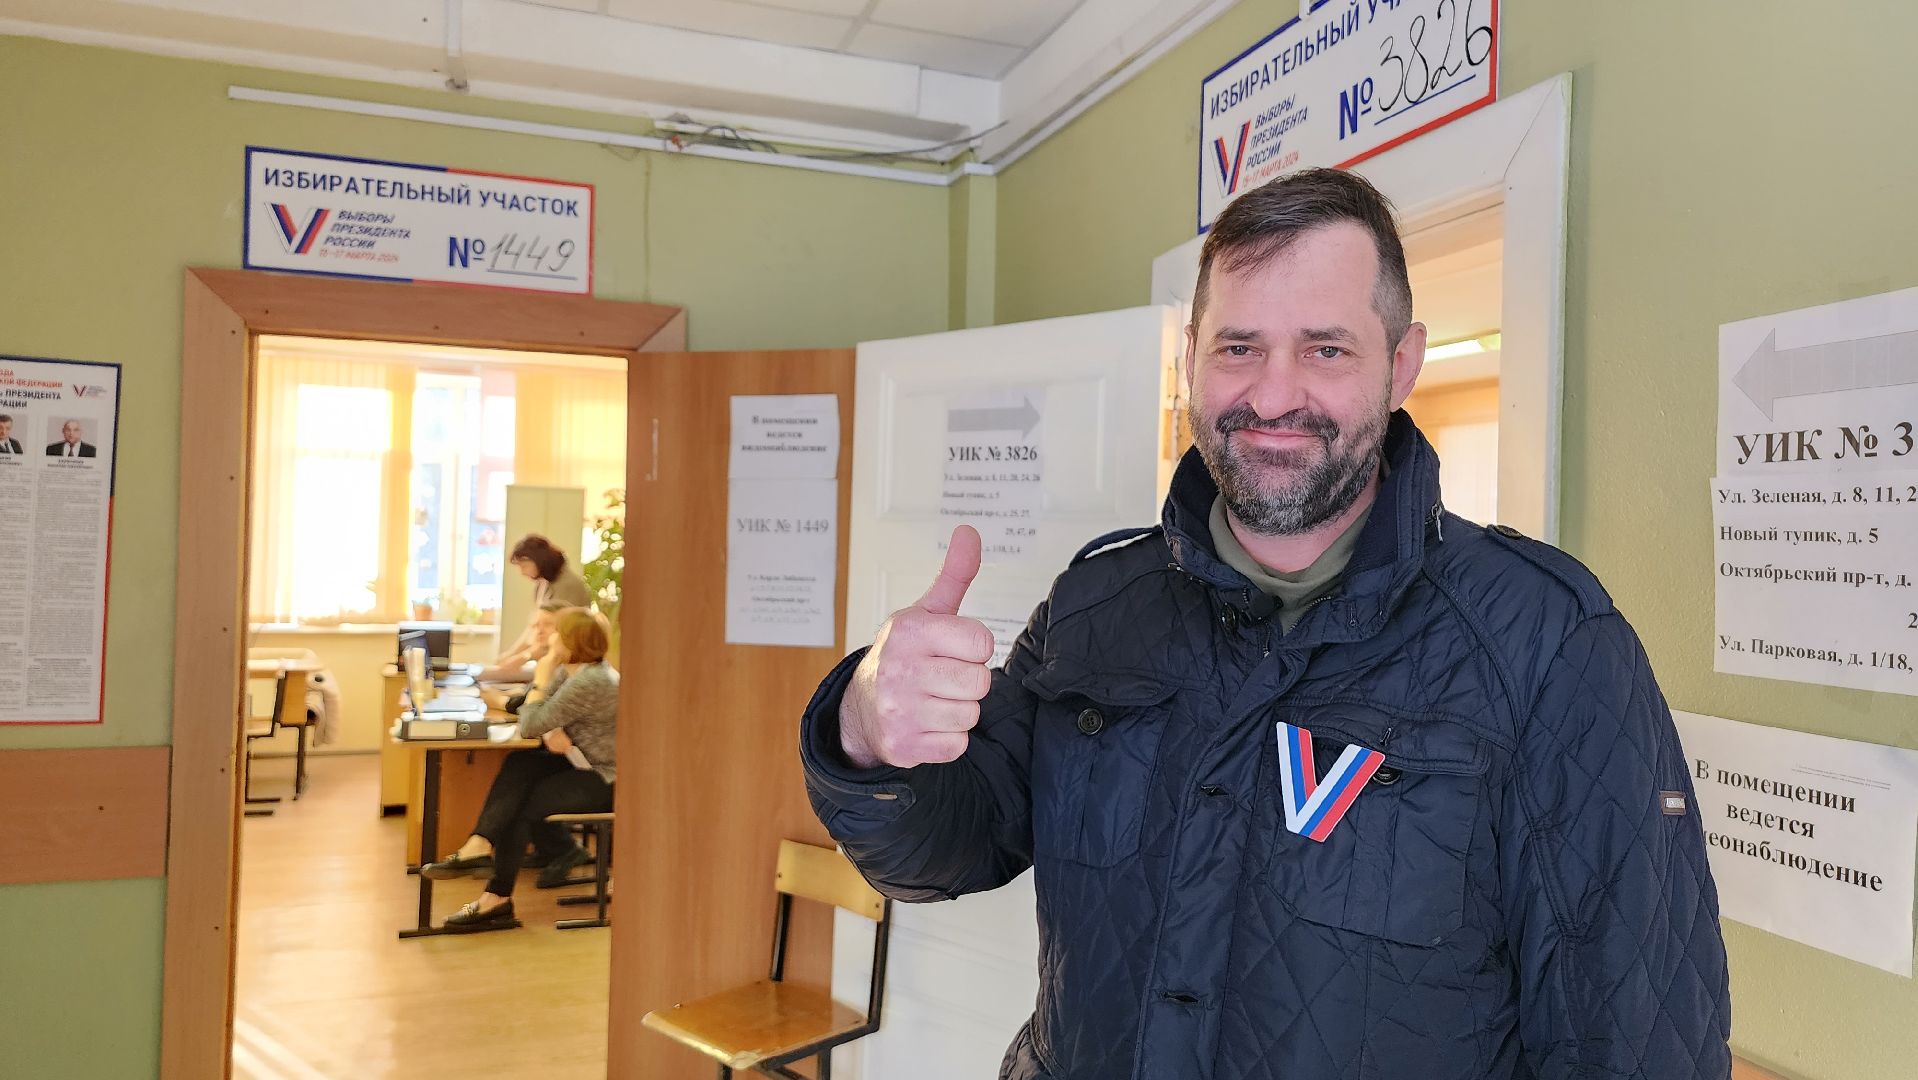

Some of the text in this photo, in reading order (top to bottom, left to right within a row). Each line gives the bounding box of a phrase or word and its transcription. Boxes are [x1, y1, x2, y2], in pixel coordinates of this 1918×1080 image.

[1210, 0, 1360, 119] ИЗБИРАТЕЛЬНЫЙ
[1379, 0, 1494, 111] 3826
[1249, 106, 1308, 149] ПРЕЗИДЕНТА
[1254, 93, 1295, 129] ВЫБОРЫ
[1245, 140, 1281, 170] РОССИИ
[264, 167, 579, 217] ИЗБИРАТЕЛЬНЫЙ УЧАСТОК
[331, 223, 411, 239] ПРЕЗИДЕНТА
[338, 209, 395, 223] ВЫБОРЫ
[324, 236, 376, 249] РОССИИ
[448, 232, 576, 272] № 1449
[947, 445, 982, 462] УИК
[1004, 445, 1038, 461] 3826
[1733, 421, 1915, 465] УИК № 3
[1718, 485, 1918, 506] Ул. Зеленая, д. 8, 11, 2
[1720, 526, 1879, 545] Новый тупик, д. 5
[1720, 562, 1912, 589] Октябрьский пр-т, д.
[1907, 612, 1918, 629] 2
[1719, 635, 1914, 674] Ул. Парковая, д. 1/18,
[1694, 758, 1710, 780] В
[1717, 768, 1857, 813] помещении
[1726, 803, 1816, 839] ведется
